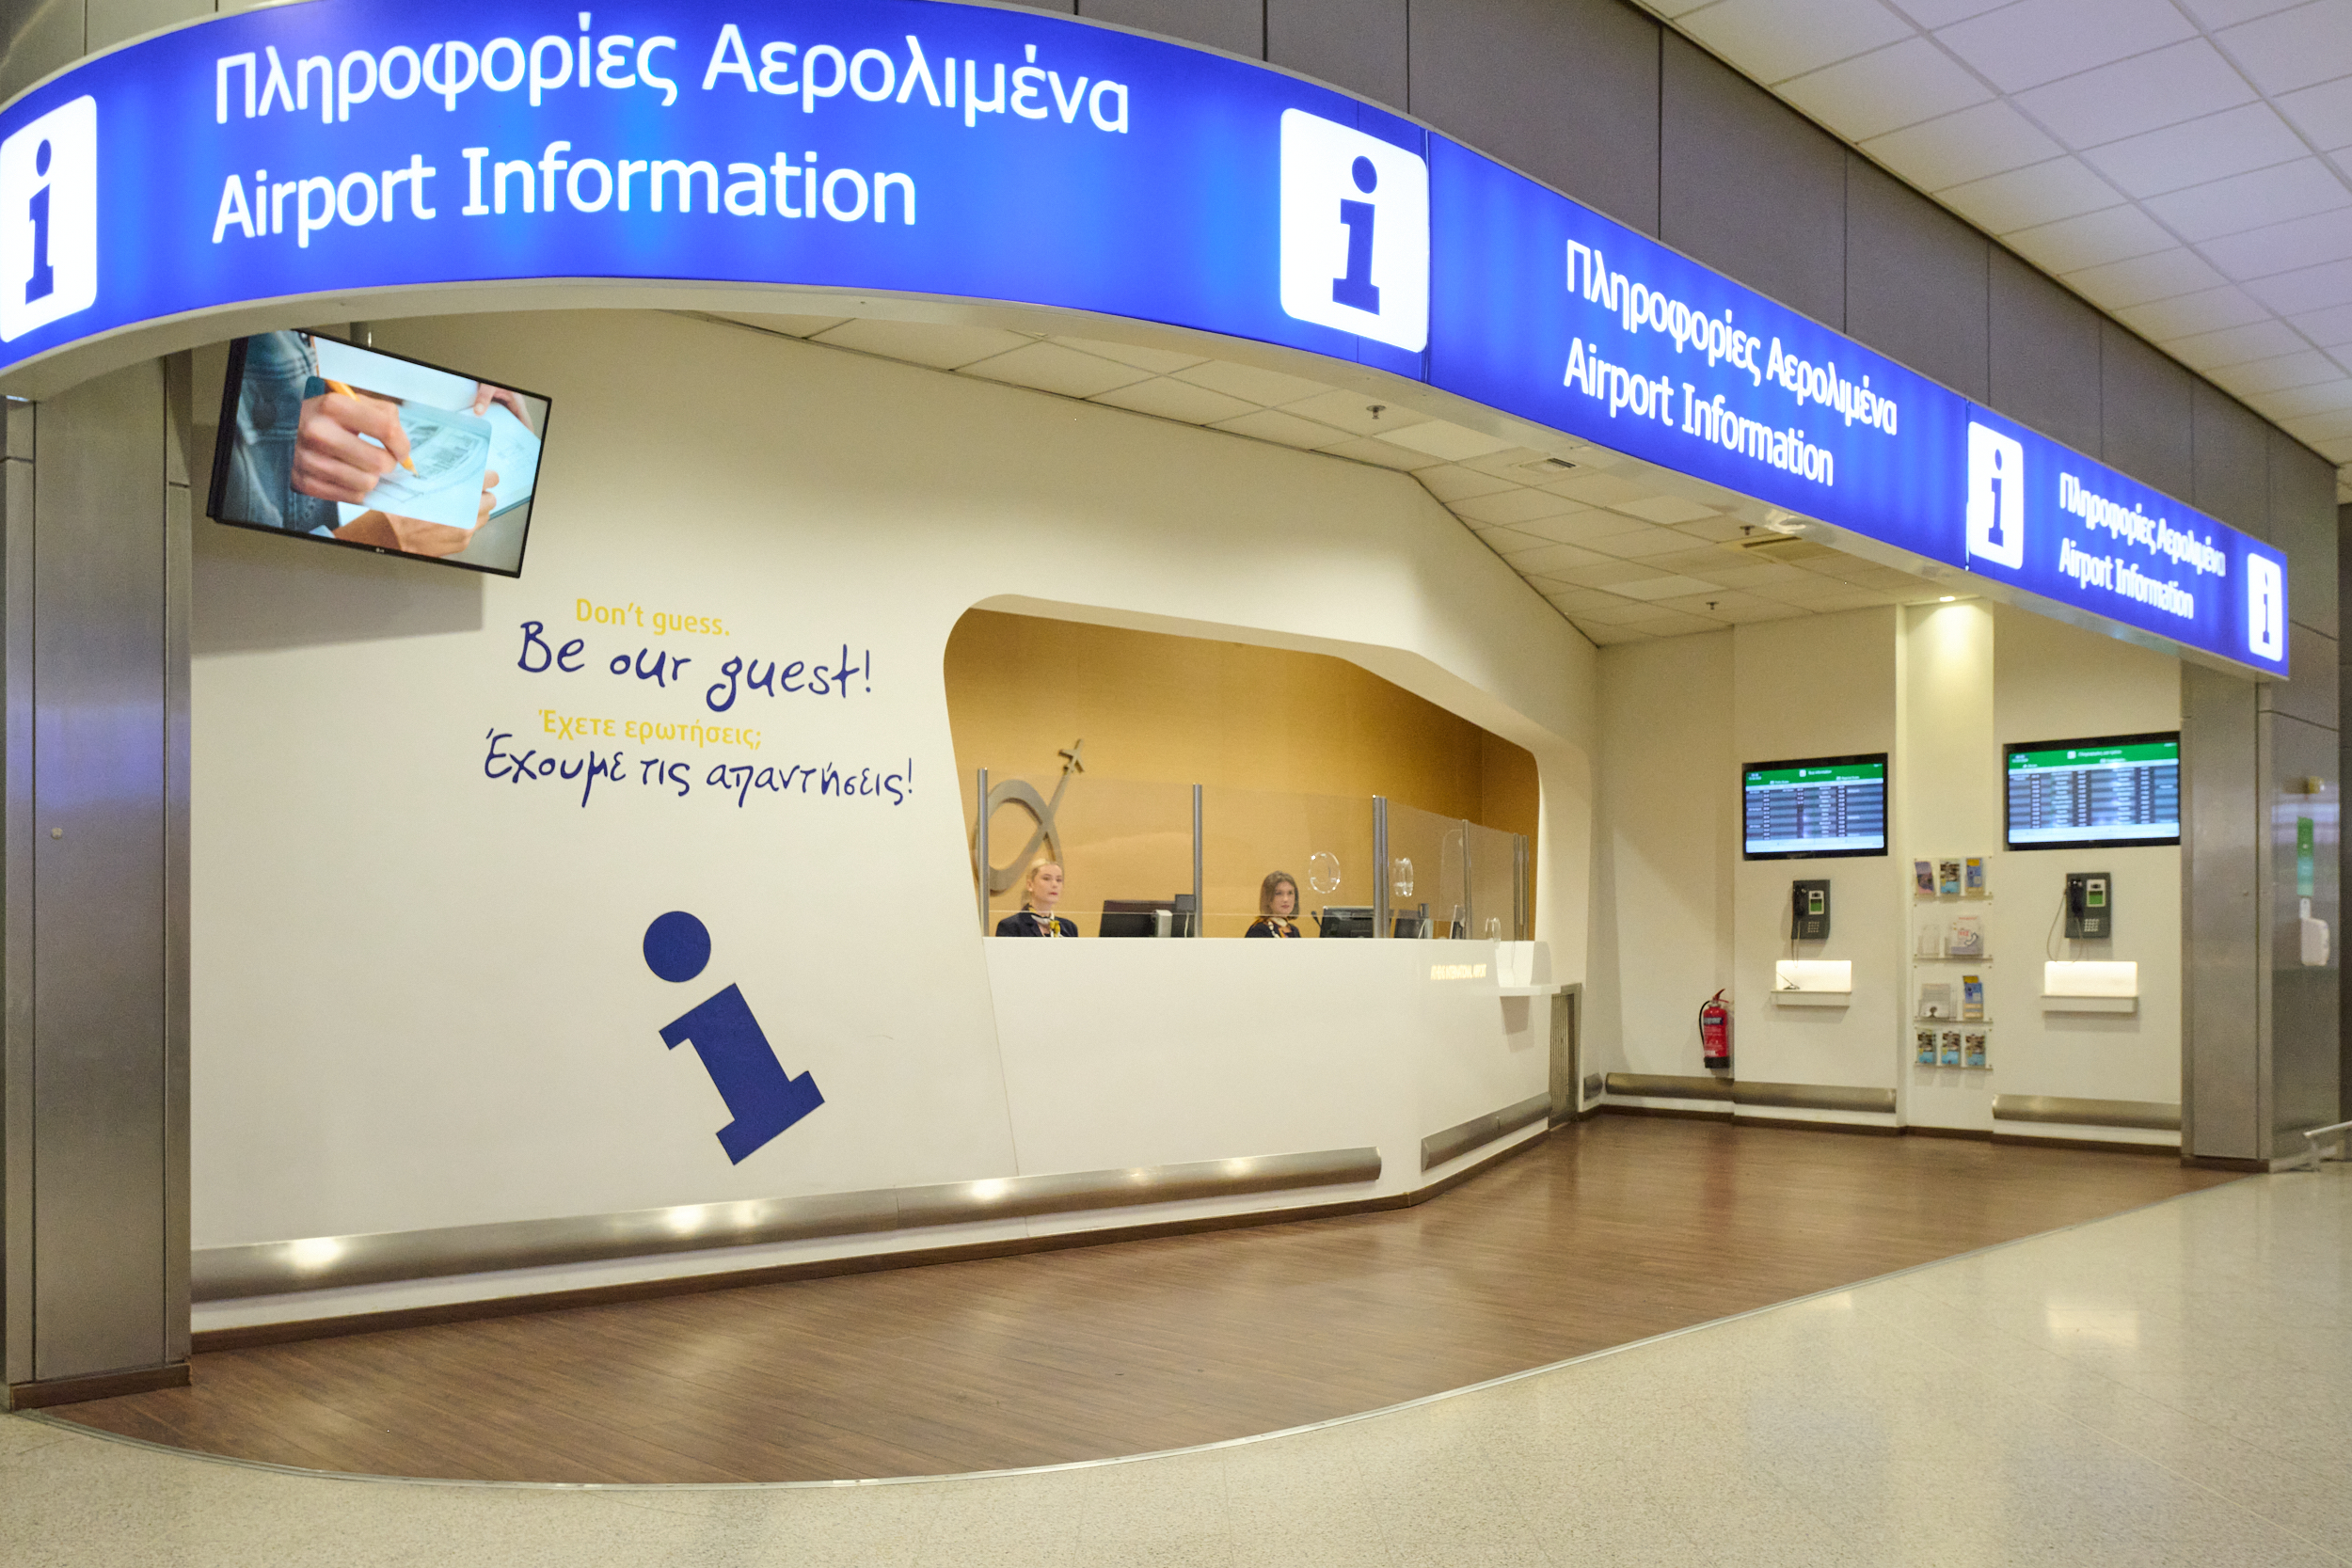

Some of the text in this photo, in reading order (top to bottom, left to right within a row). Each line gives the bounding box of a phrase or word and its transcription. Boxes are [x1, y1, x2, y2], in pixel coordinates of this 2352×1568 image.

[216, 11, 1129, 134] Πληροφορίες Αερολιμένα
[212, 140, 916, 248] Airport Information
[1566, 238, 1897, 436] Πληροφορίες Αερολιμένα
[1563, 337, 1834, 487] Airport Information
[652, 610, 731, 636] guess.
[2058, 537, 2194, 620] Airport Information
[516, 620, 872, 713] Be our guest!
[484, 727, 627, 809] Έχουμε
[640, 756, 691, 797] τις
[538, 709, 617, 741] Έχετε
